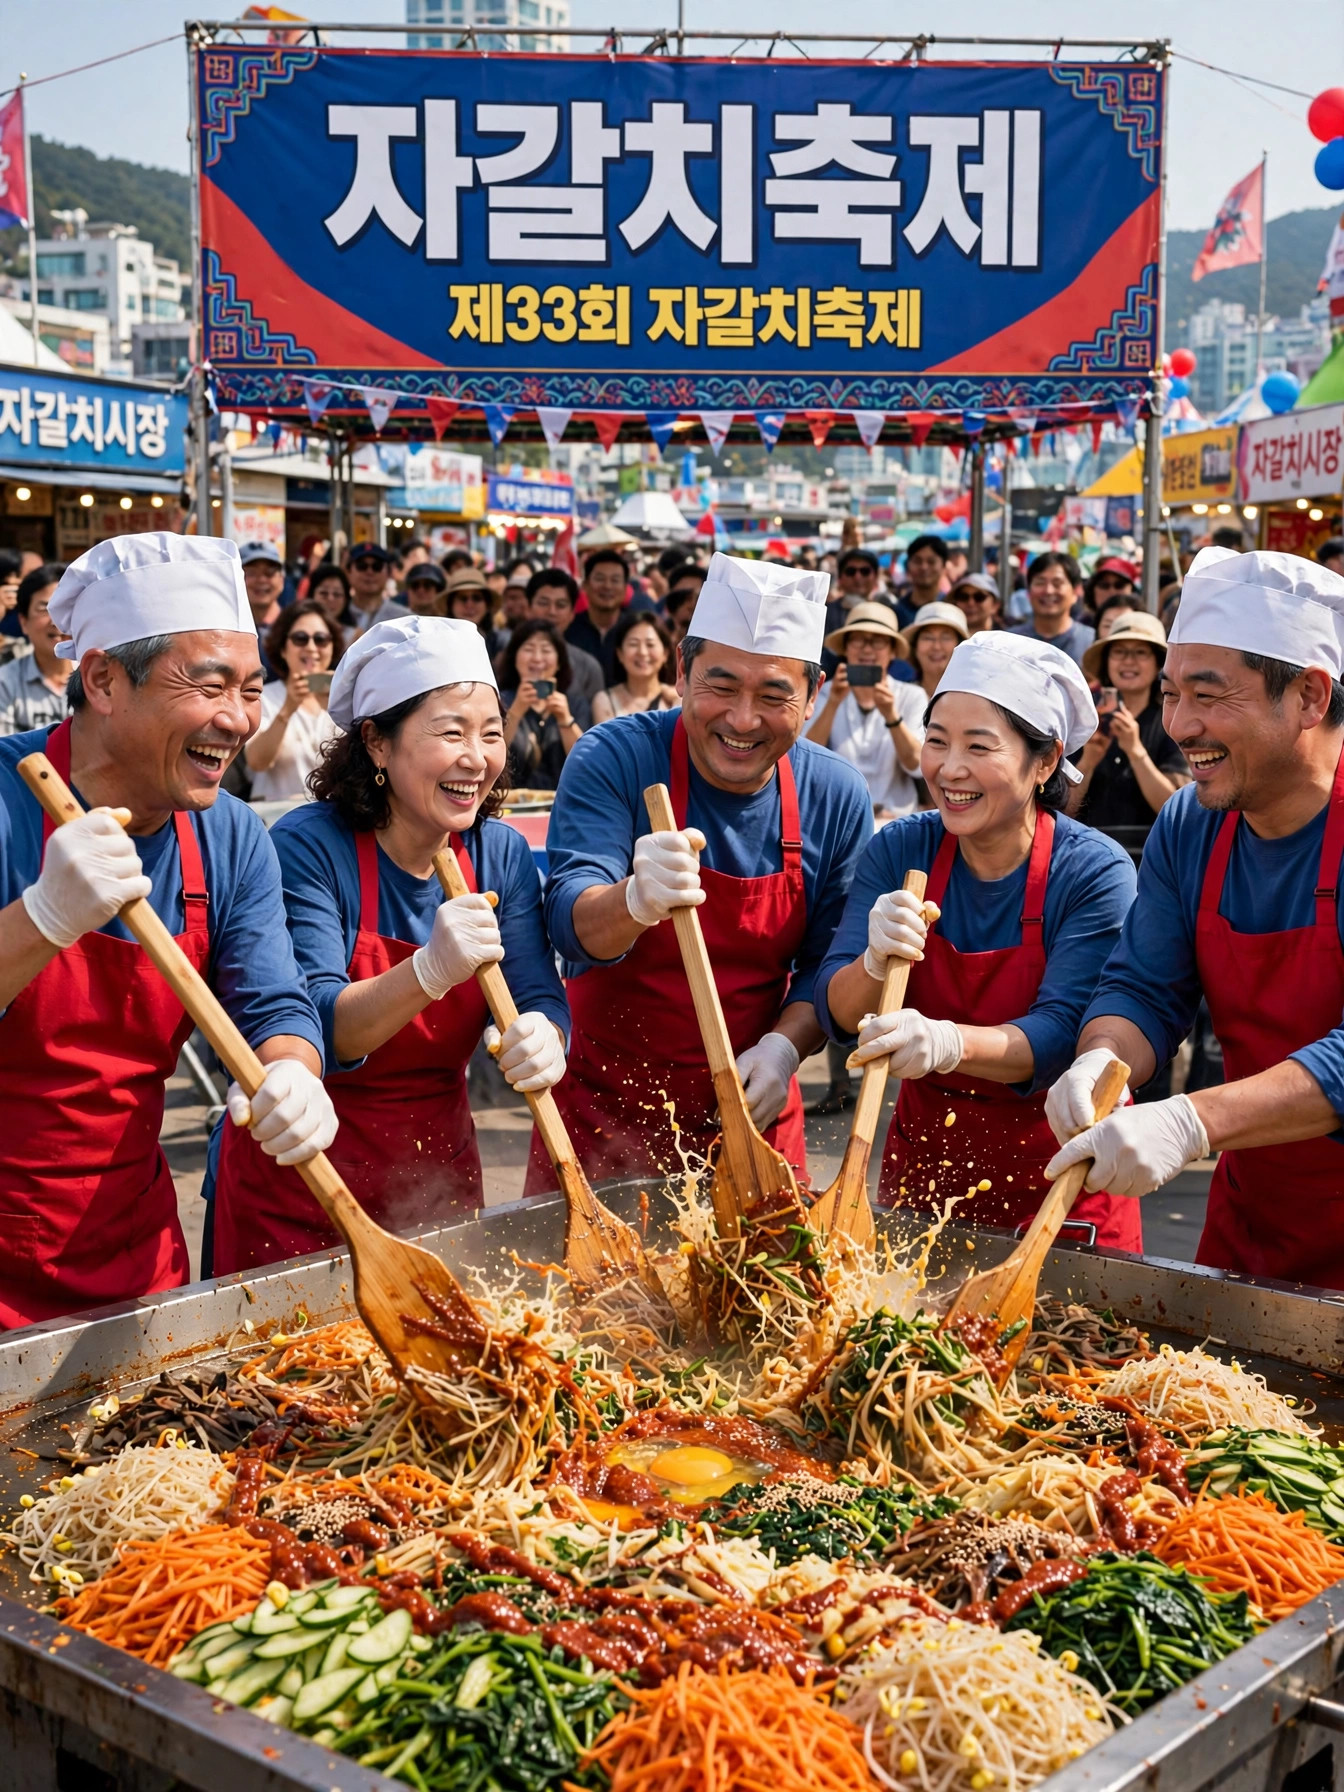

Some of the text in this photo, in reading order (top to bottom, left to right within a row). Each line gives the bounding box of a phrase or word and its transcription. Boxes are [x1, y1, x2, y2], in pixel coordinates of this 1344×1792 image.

[324, 99, 1041, 267] 자갈치축제
[449, 284, 921, 348] 제33회 자갈치축제
[0, 386, 169, 458] 자갈치시장
[1251, 427, 1342, 482] 자갈치시장
